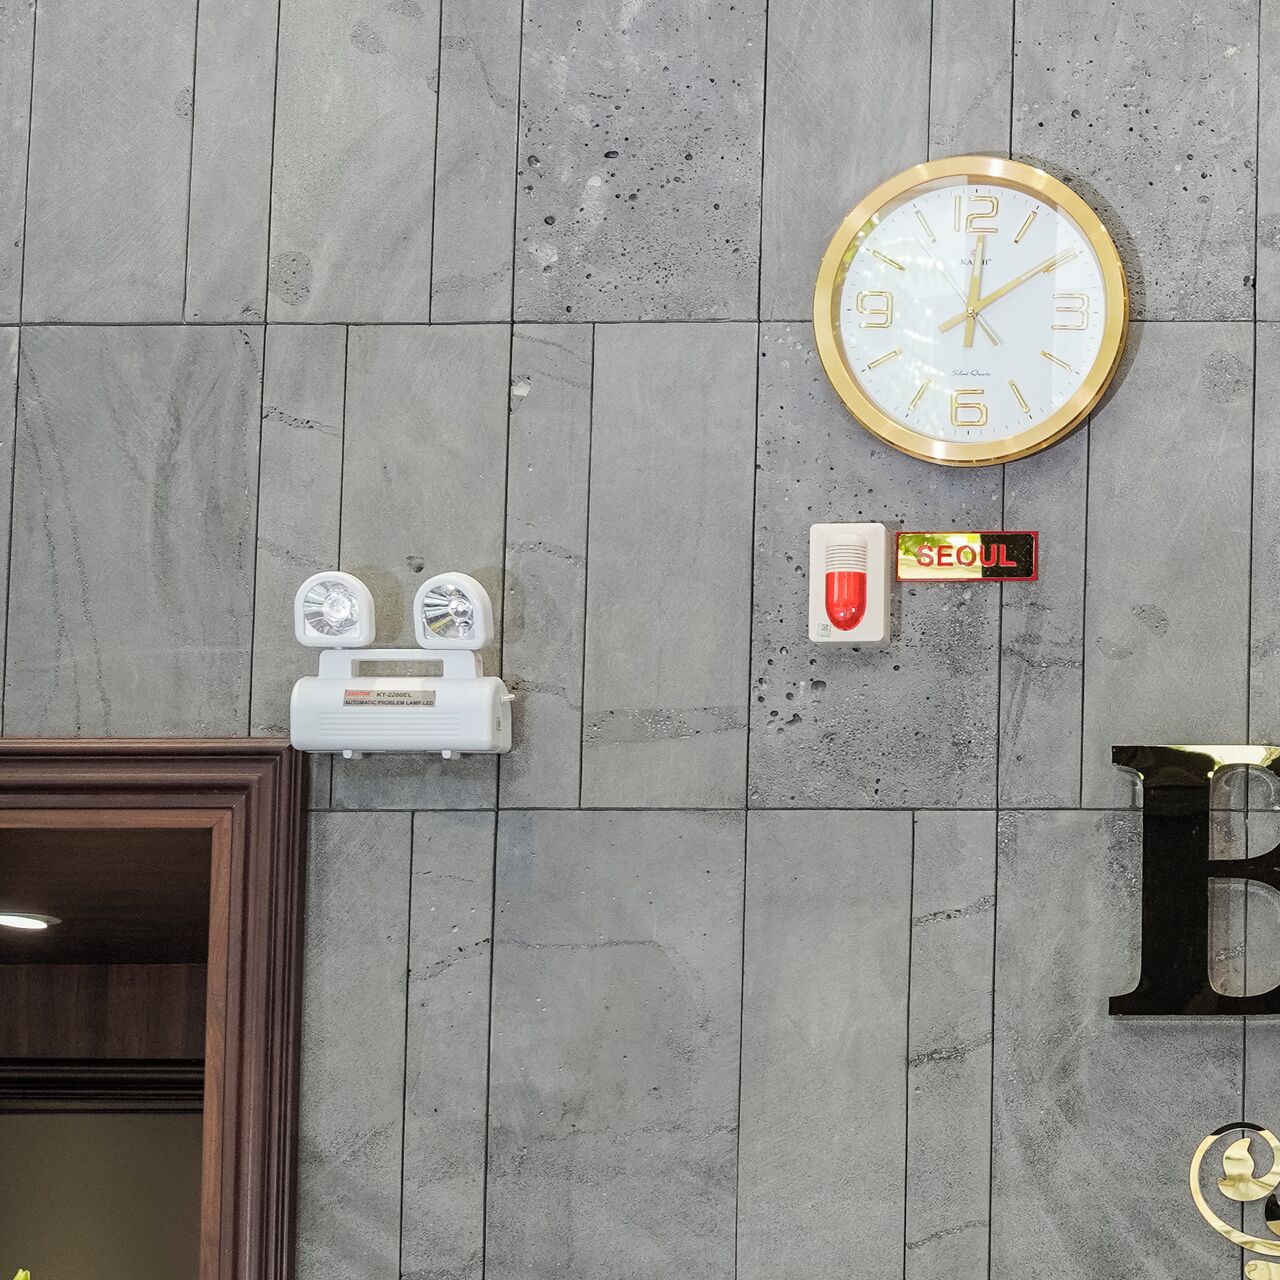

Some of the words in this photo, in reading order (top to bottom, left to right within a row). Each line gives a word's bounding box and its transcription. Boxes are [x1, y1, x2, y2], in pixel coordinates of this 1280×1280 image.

[953, 195, 999, 233] 12
[856, 290, 893, 328] 9
[1051, 292, 1089, 330] 3
[950, 389, 988, 427] 6
[916, 543, 1017, 569] SEOUL
